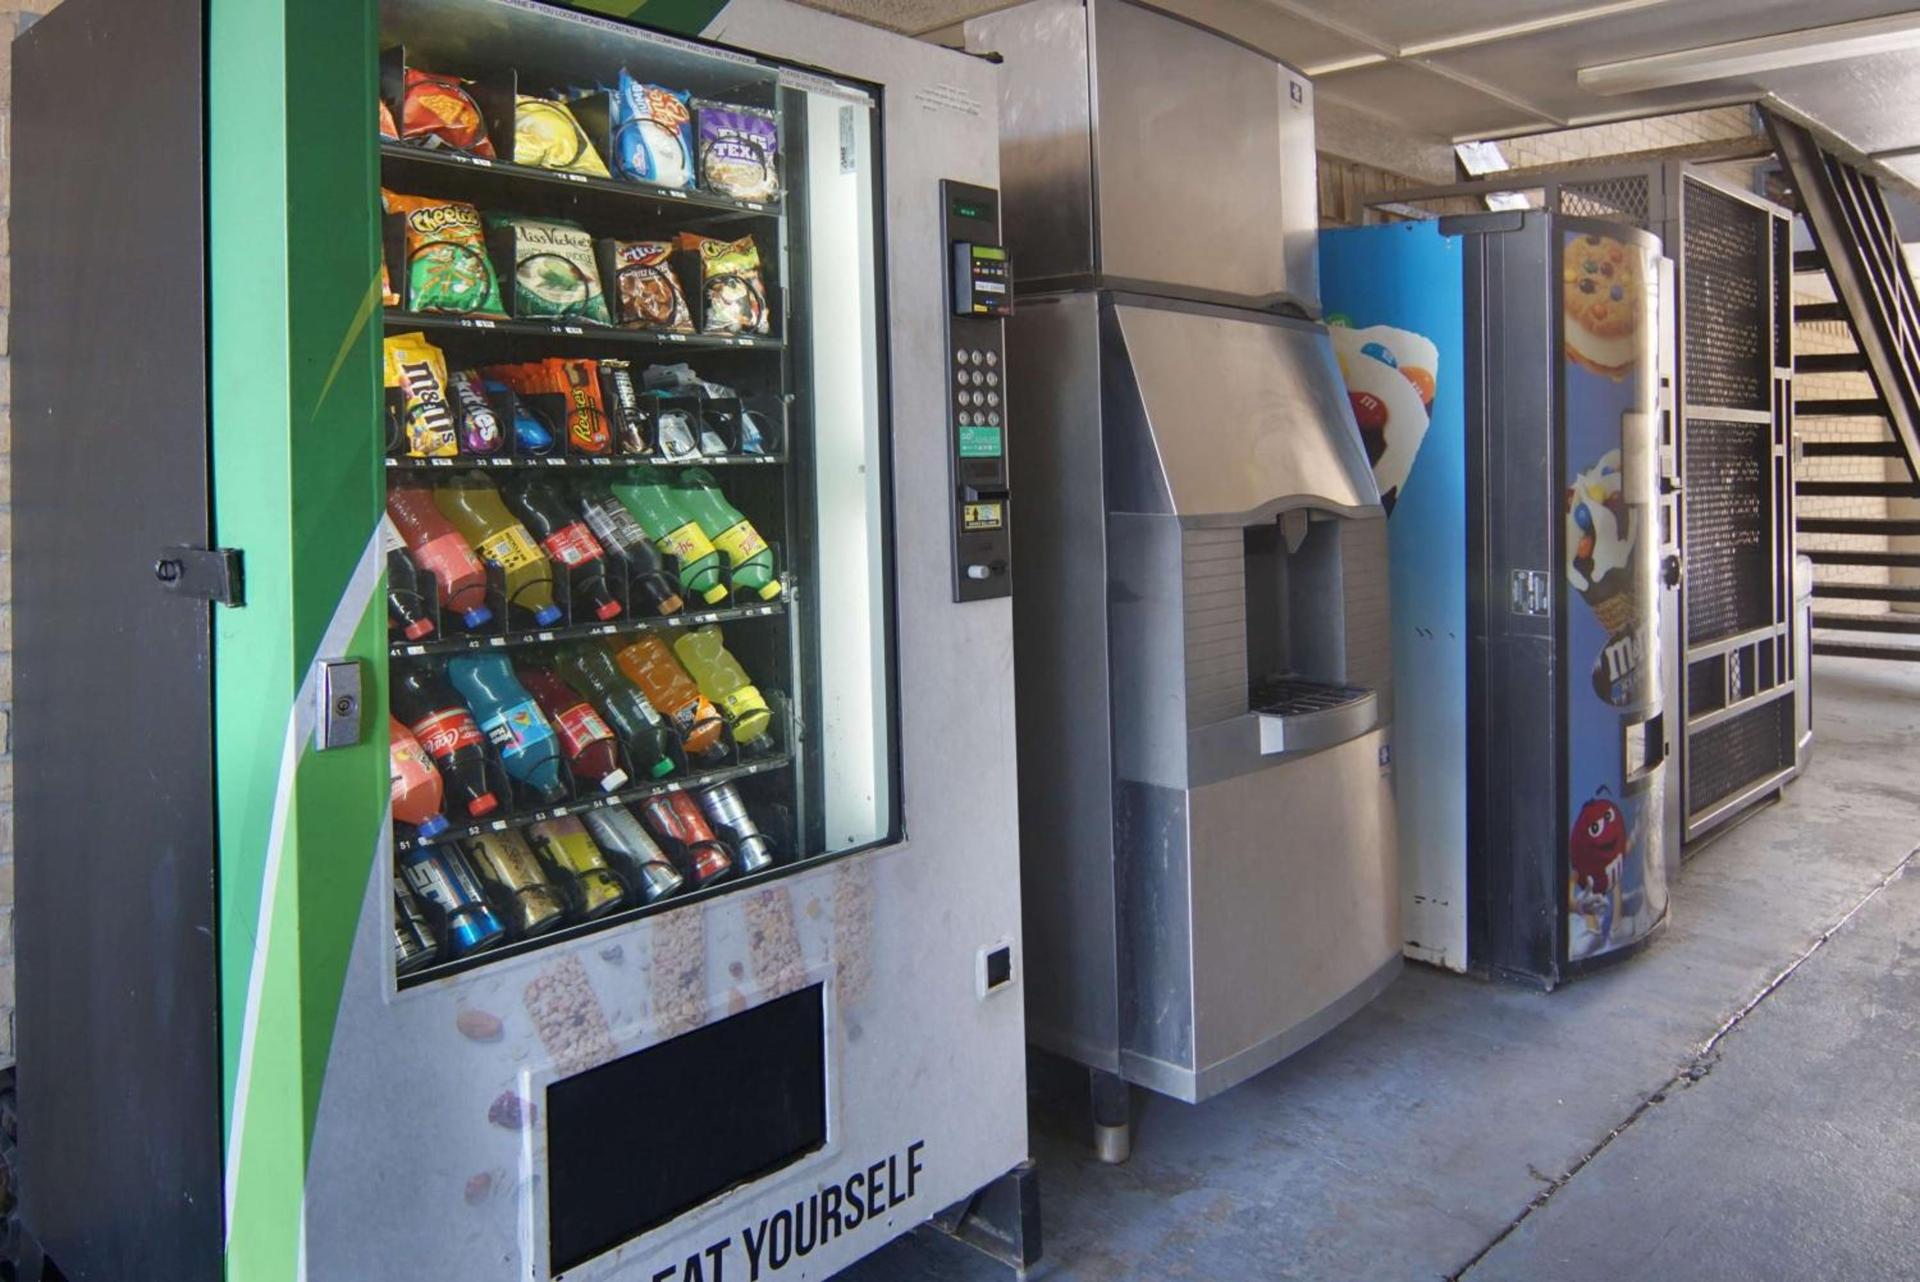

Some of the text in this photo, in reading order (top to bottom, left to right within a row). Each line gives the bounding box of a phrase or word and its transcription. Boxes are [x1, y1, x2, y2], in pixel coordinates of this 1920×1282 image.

[468, 826, 479, 834] 52
[400, 841, 410, 849] 51
[742, 1139, 924, 1282] YOURSELF
